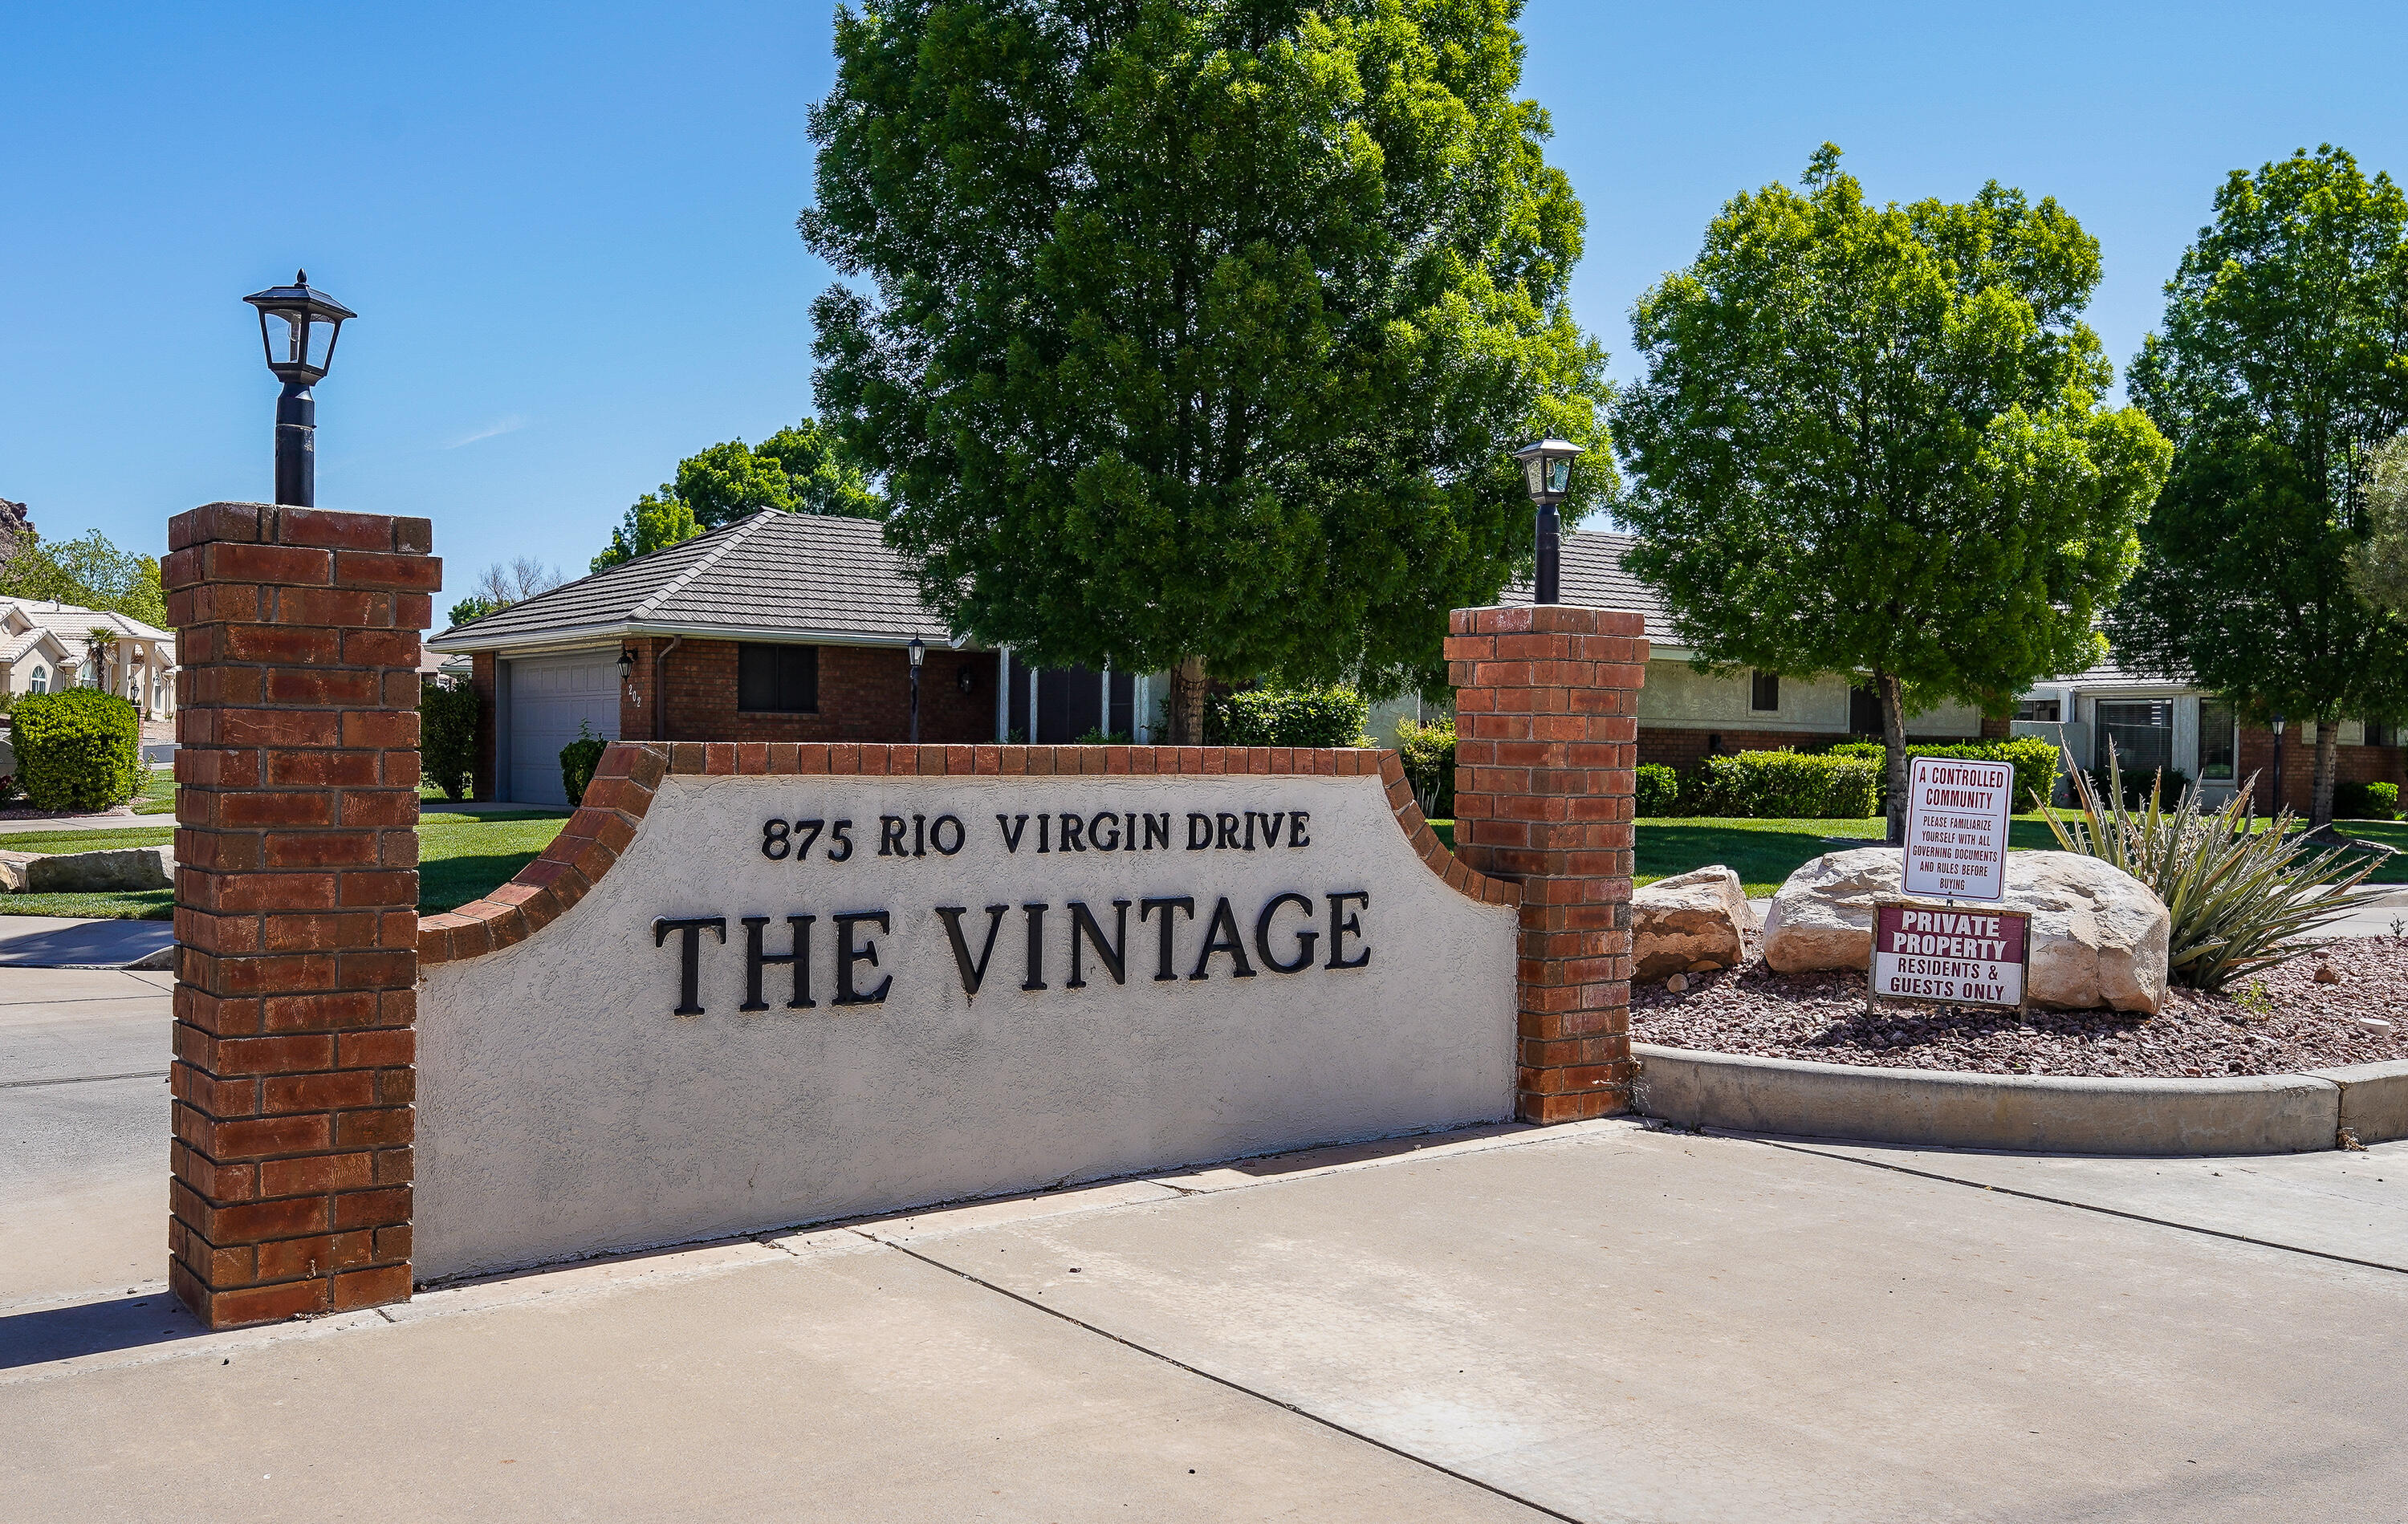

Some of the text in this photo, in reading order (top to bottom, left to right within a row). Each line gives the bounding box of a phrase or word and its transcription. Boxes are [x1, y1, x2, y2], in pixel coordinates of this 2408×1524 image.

[628, 684, 641, 707] 202
[1919, 766, 2003, 788] A CONTROLLED
[1926, 788, 1993, 810] COMMUNITY
[1923, 815, 1991, 831] PLEASE FAMILIARIZE
[761, 811, 1312, 862] 875 RIO VIRGIN DRIVE
[1922, 831, 1991, 846] YOURSELF WITH ALL
[1913, 845, 1998, 862] GOVERNING DOCUMENTS
[1919, 861, 1988, 876] AND RULES BEFORE
[1939, 878, 1965, 890] BUYING
[1902, 910, 2000, 937] PRIVATE
[653, 890, 1373, 1017] THE VINTAGE
[1892, 931, 2007, 961] PROPERTY
[1898, 957, 1998, 981] RESIDENTS &
[1890, 977, 2004, 1001] GUESTS ONLY
